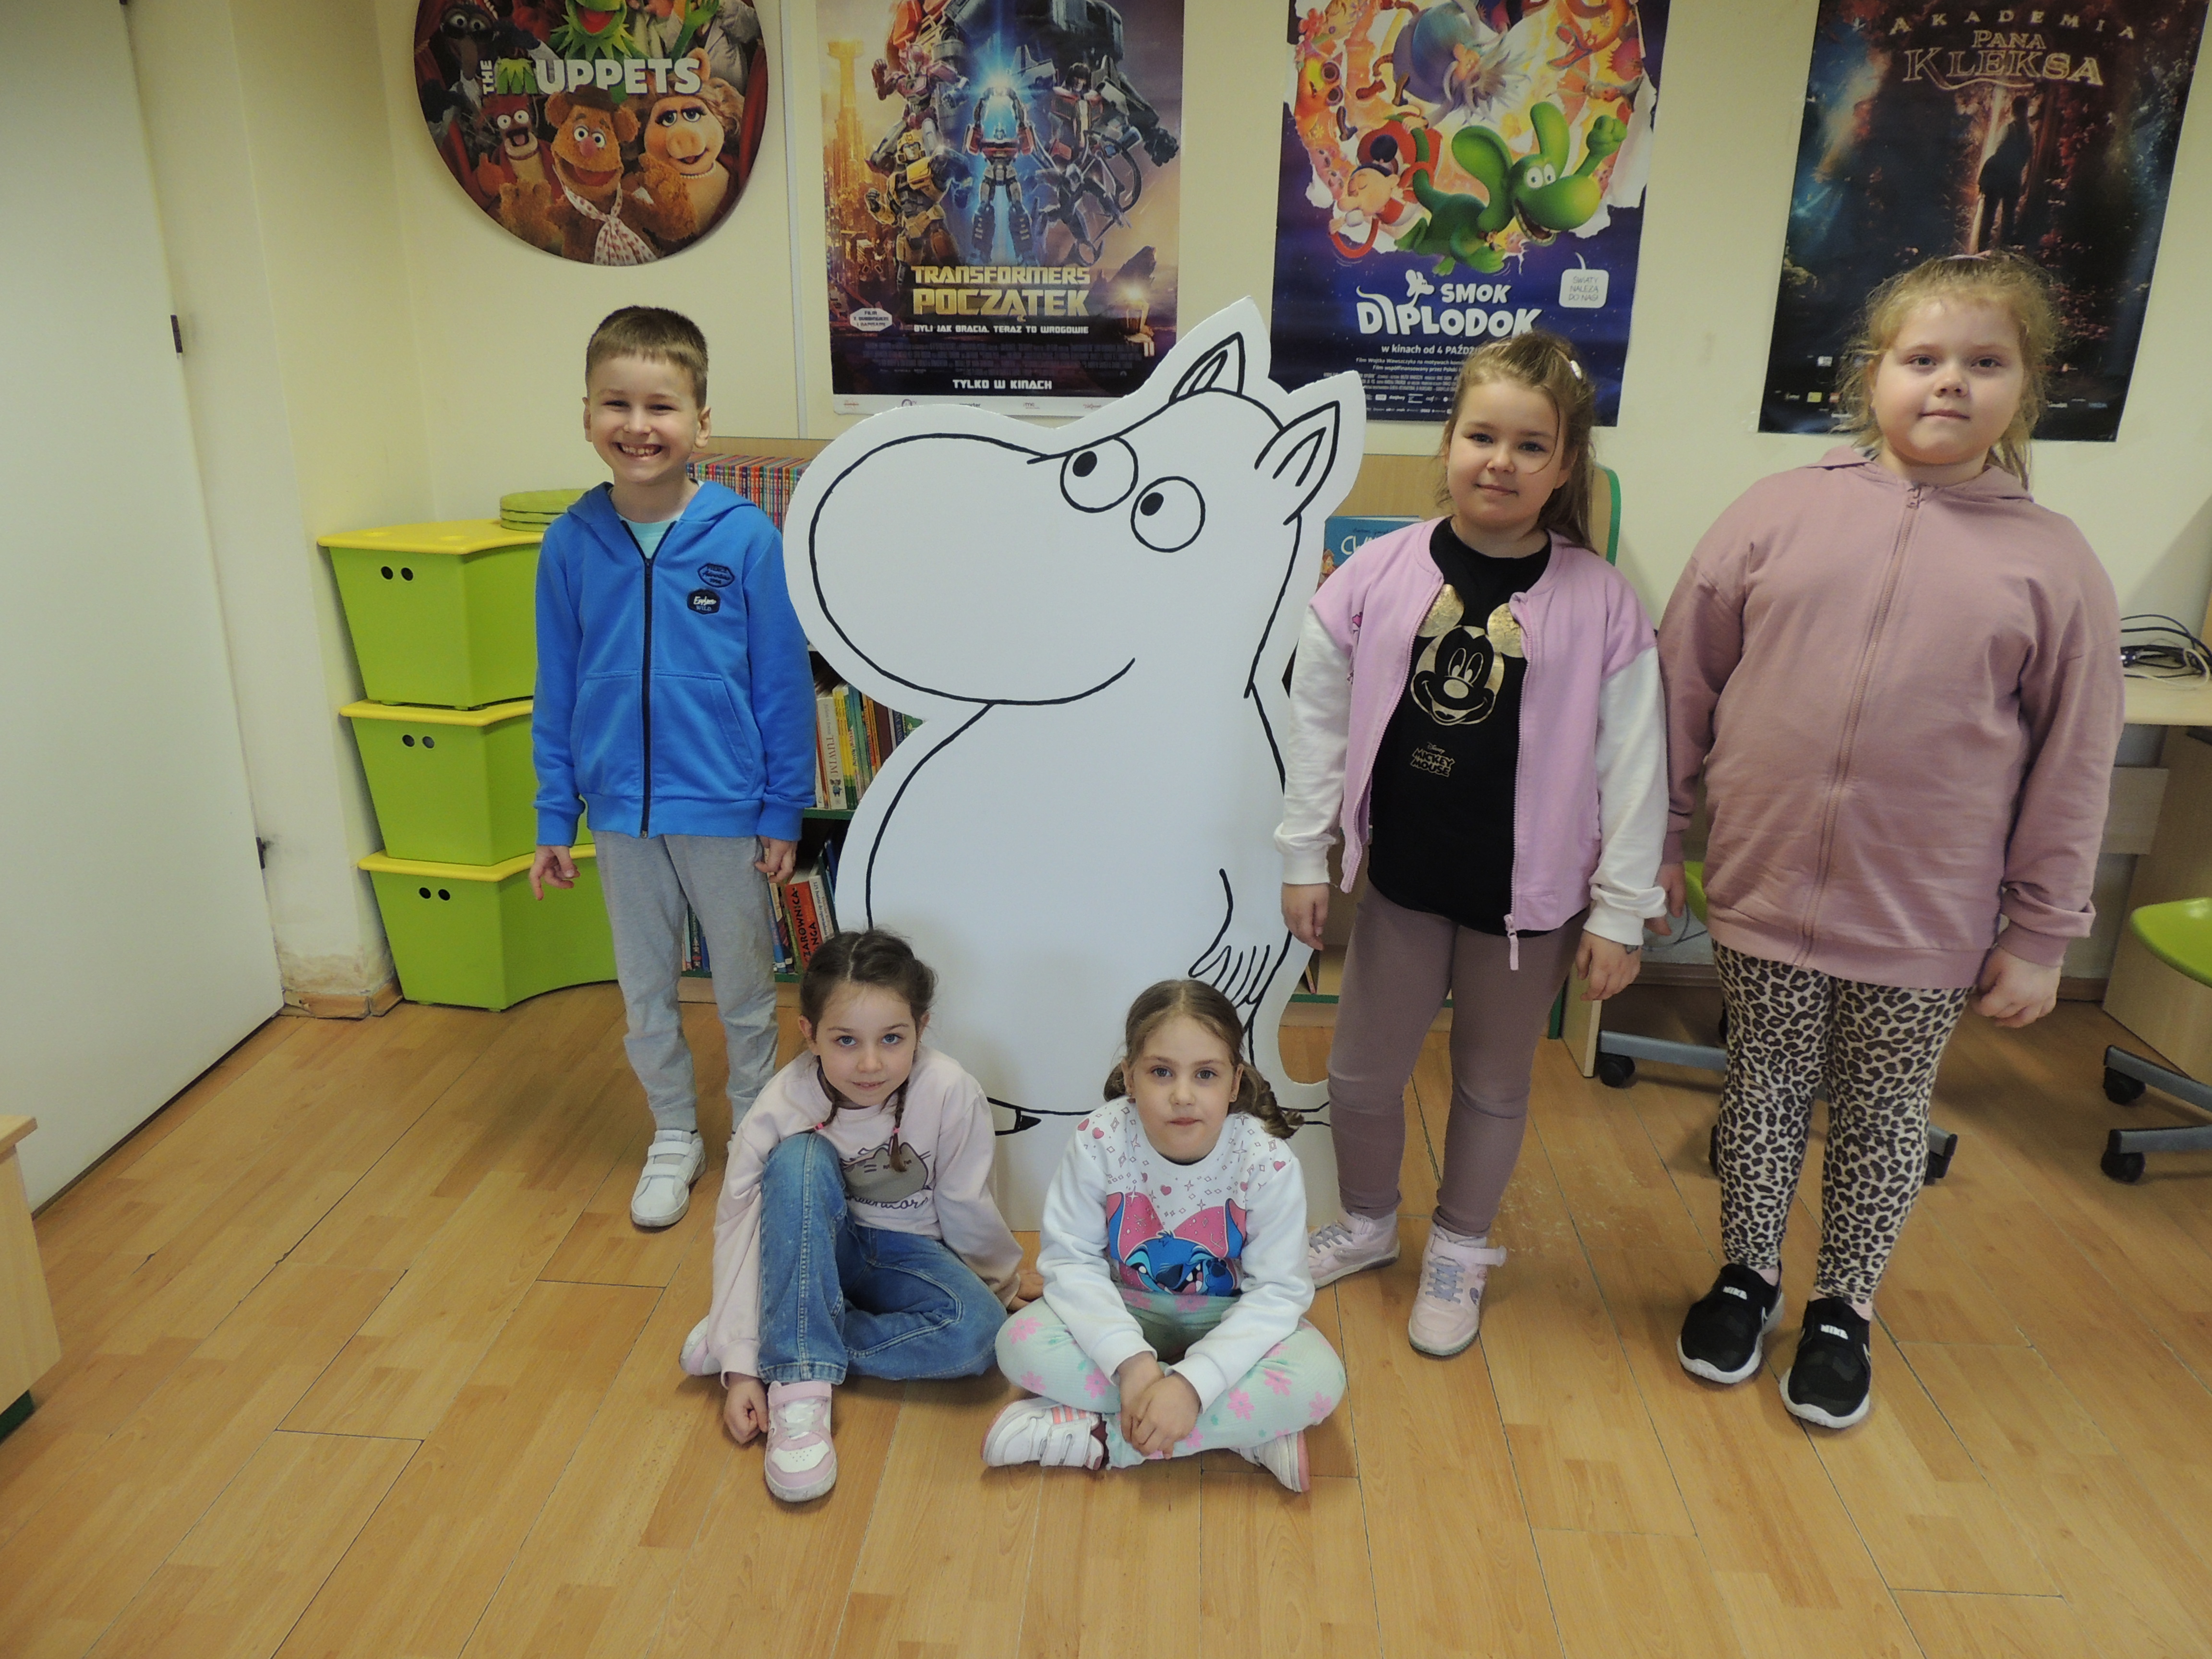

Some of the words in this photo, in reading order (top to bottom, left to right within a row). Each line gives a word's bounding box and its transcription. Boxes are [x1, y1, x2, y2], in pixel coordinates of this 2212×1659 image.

[1889, 10, 2135, 39] AKADEMIA
[1972, 30, 2046, 49] PANA
[480, 60, 494, 95] THE
[495, 58, 702, 95] MUPPETS
[1903, 47, 2104, 90] KLEKSA
[911, 266, 1090, 284] TRANSFORMERS
[1440, 283, 1511, 304] SMOK
[913, 289, 1089, 323] POCZĄTEK
[1357, 294, 1542, 337] DIPLODOK
[1040, 326, 1089, 334] WROGOWIE
[1392, 344, 1421, 353] kinach
[1423, 345, 1435, 354] od
[1437, 346, 1443, 354] 4
[1445, 344, 1477, 355] PAŹDZ
[953, 380, 989, 389] TYLKO
[994, 380, 1006, 389] W
[1010, 380, 1052, 390] KINACH
[826, 735, 838, 774] TUWIM
[1412, 748, 1455, 767] MICKEY
[1410, 759, 1452, 777] MOUSE
[810, 922, 819, 947] NGA
[1723, 1286, 1747, 1300] NIKE
[1821, 1324, 1849, 1339] NIKE
